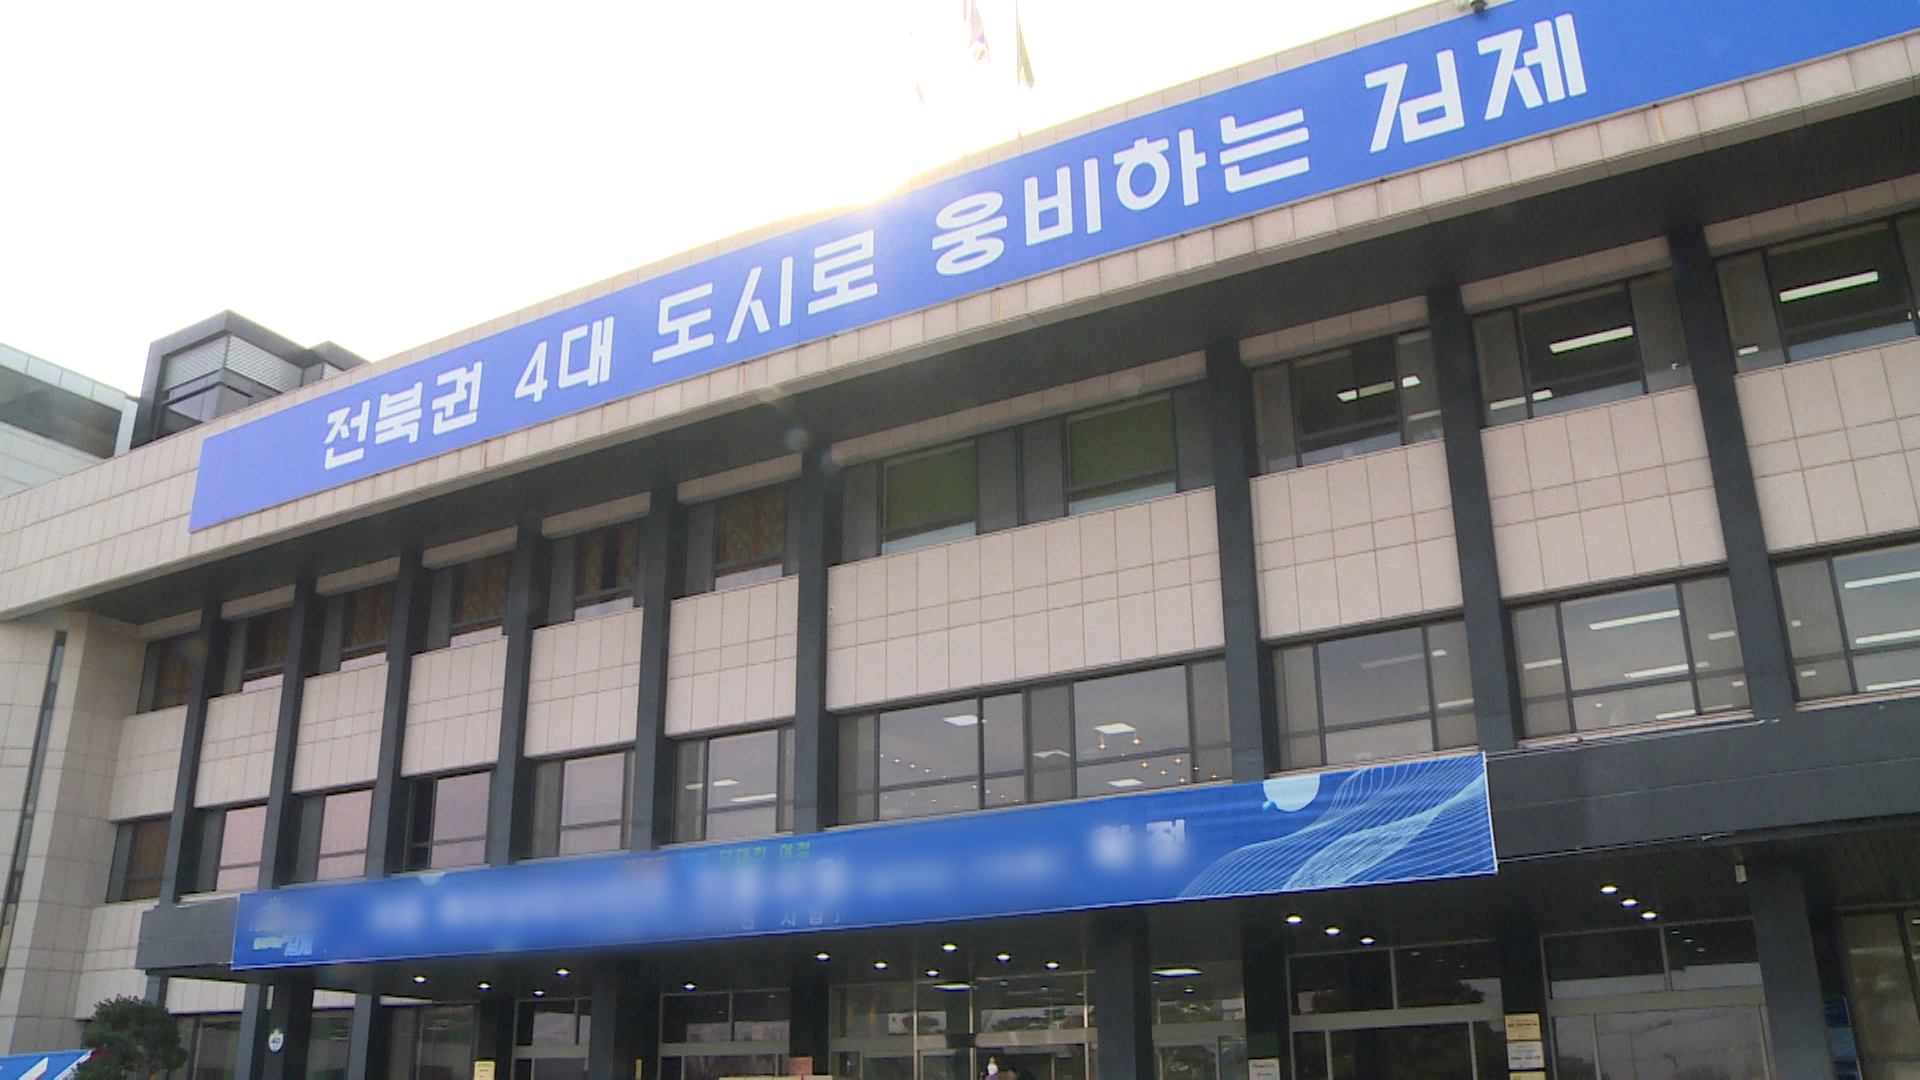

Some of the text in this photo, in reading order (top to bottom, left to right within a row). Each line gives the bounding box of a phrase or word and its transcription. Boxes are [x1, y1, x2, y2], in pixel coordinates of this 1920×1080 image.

[324, 13, 1588, 469] 전북권 4대 도시로 웅비하는 김제
